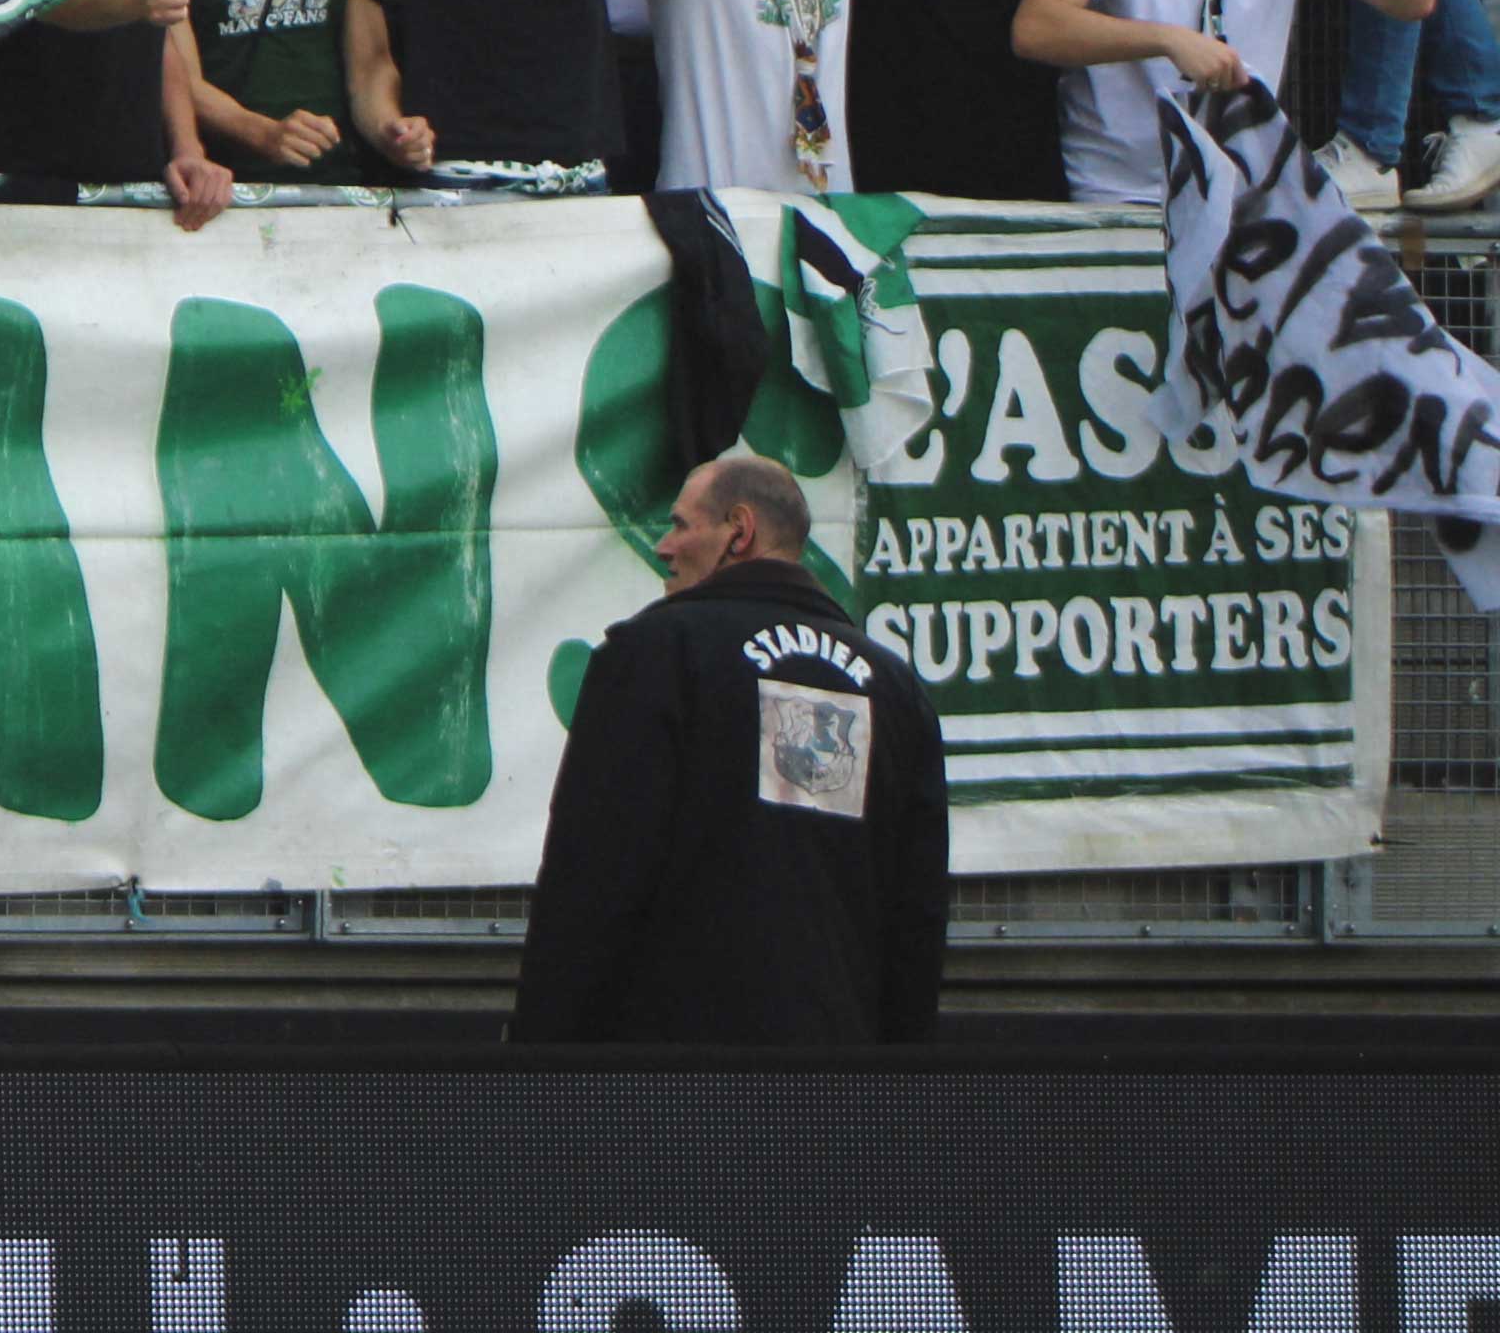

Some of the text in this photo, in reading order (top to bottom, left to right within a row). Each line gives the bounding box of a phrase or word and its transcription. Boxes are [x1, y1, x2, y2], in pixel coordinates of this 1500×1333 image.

[219, 10, 278, 36] MAGC
[864, 493, 1355, 576] APPARTIENT À SES
[743, 629, 873, 690] STADIER
[864, 589, 1355, 683] SUPPORTERS
